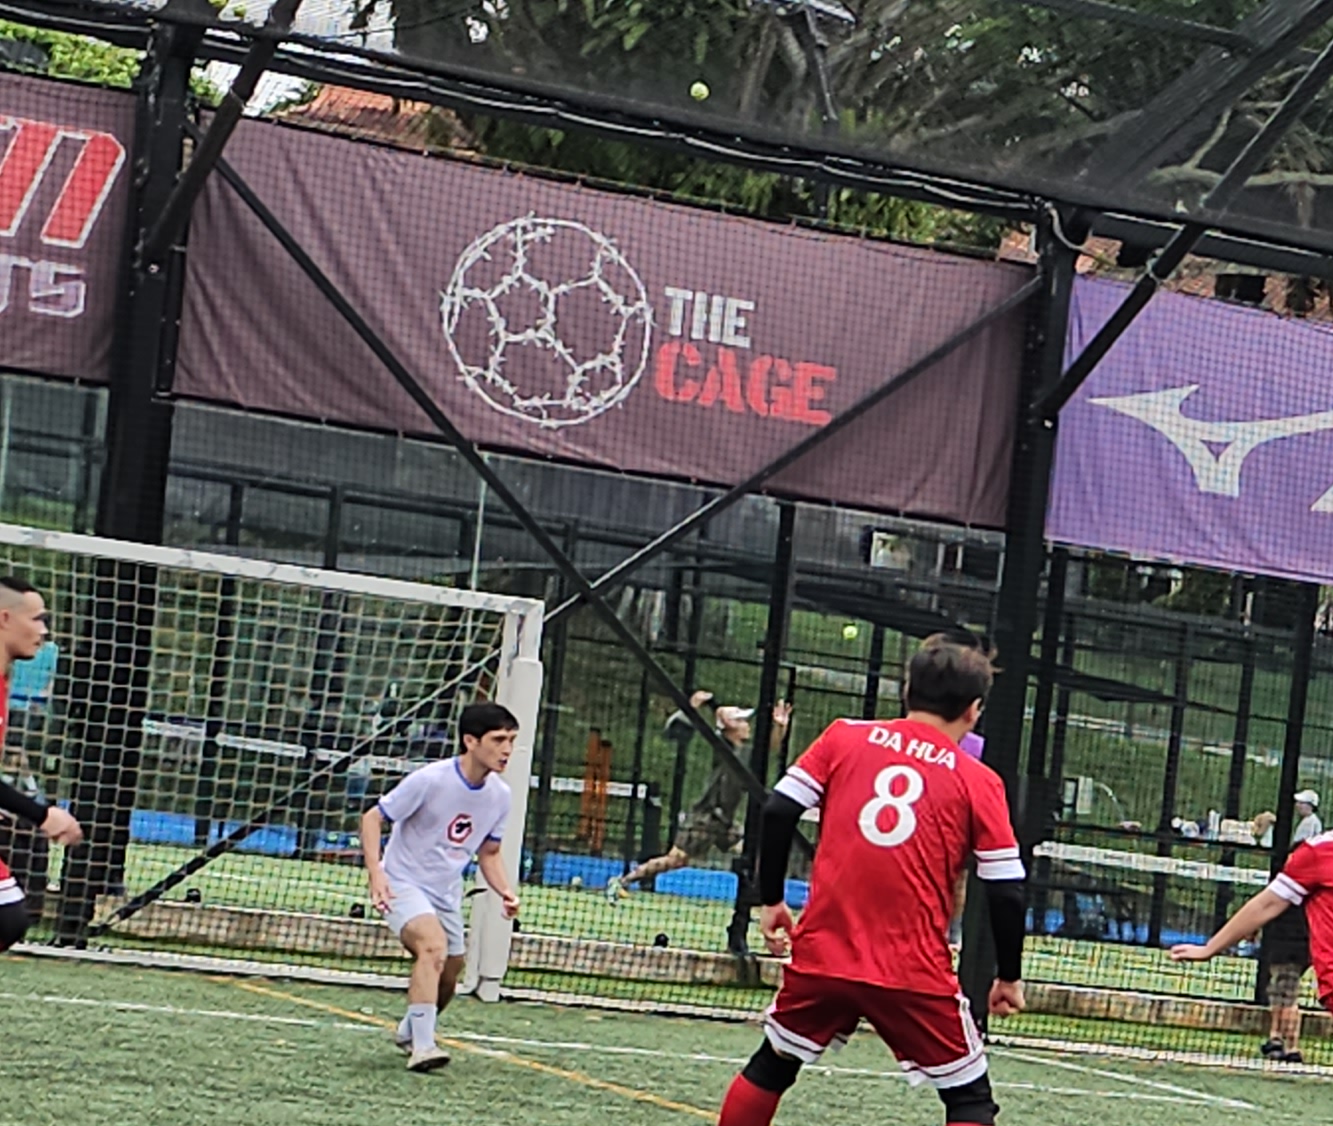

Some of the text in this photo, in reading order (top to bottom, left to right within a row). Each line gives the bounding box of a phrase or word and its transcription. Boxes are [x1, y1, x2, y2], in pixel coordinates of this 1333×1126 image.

[664, 286, 755, 348] THE
[655, 340, 837, 426] CAGE
[867, 726, 956, 770] DA HUA
[858, 765, 924, 846] 8
